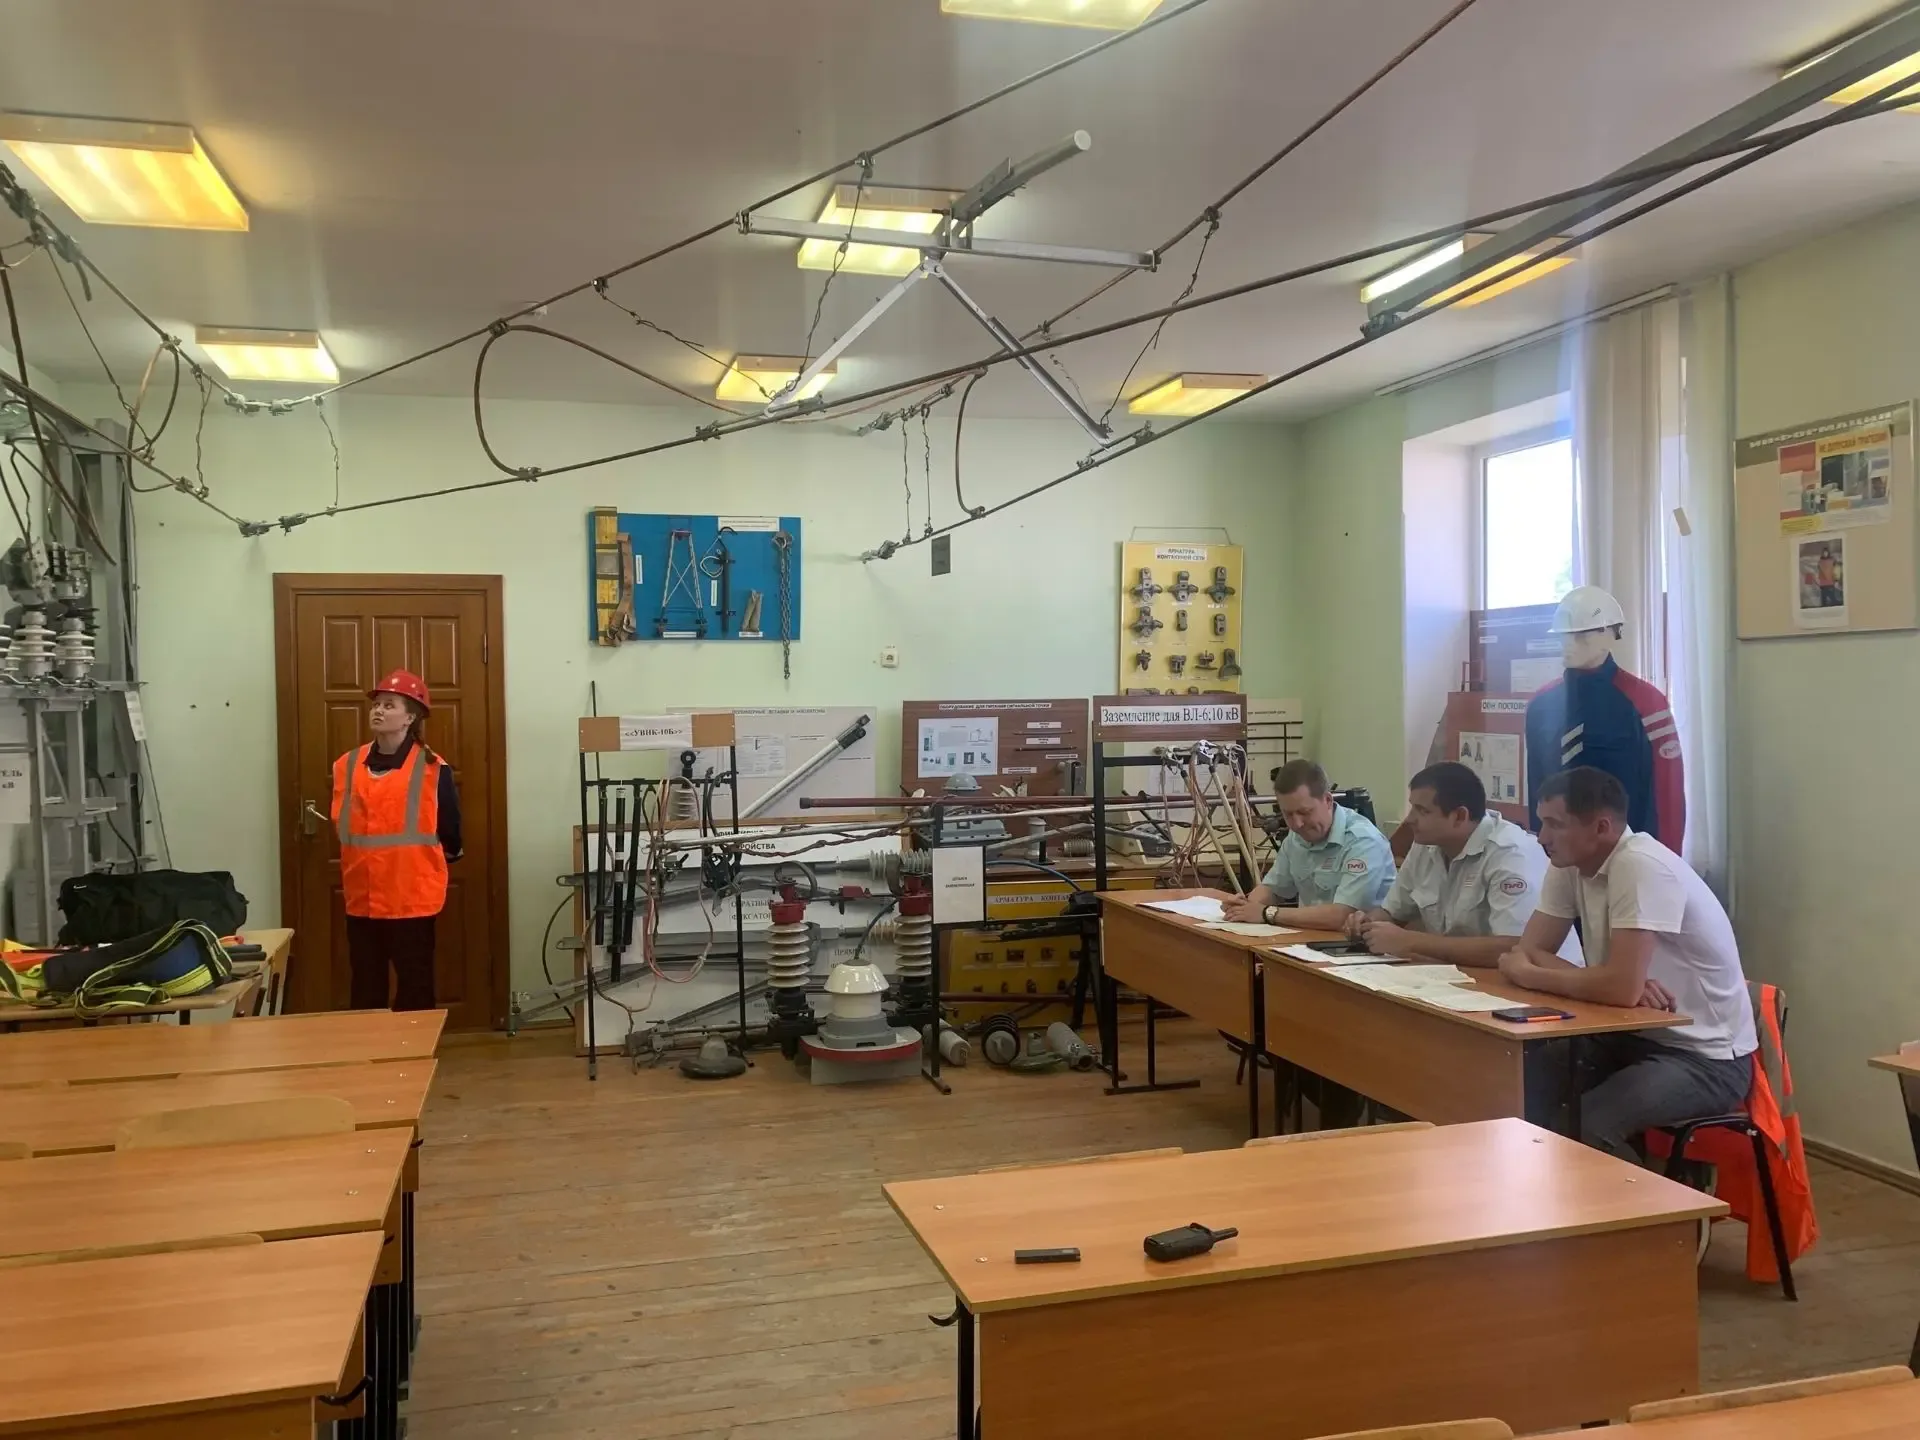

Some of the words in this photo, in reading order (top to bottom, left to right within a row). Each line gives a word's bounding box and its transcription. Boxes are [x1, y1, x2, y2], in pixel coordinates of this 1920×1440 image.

[1102, 708, 1160, 722] Заземление
[1162, 711, 1180, 723] для
[1225, 707, 1239, 720] кВ
[740, 843, 776, 851] РОЙСТВА
